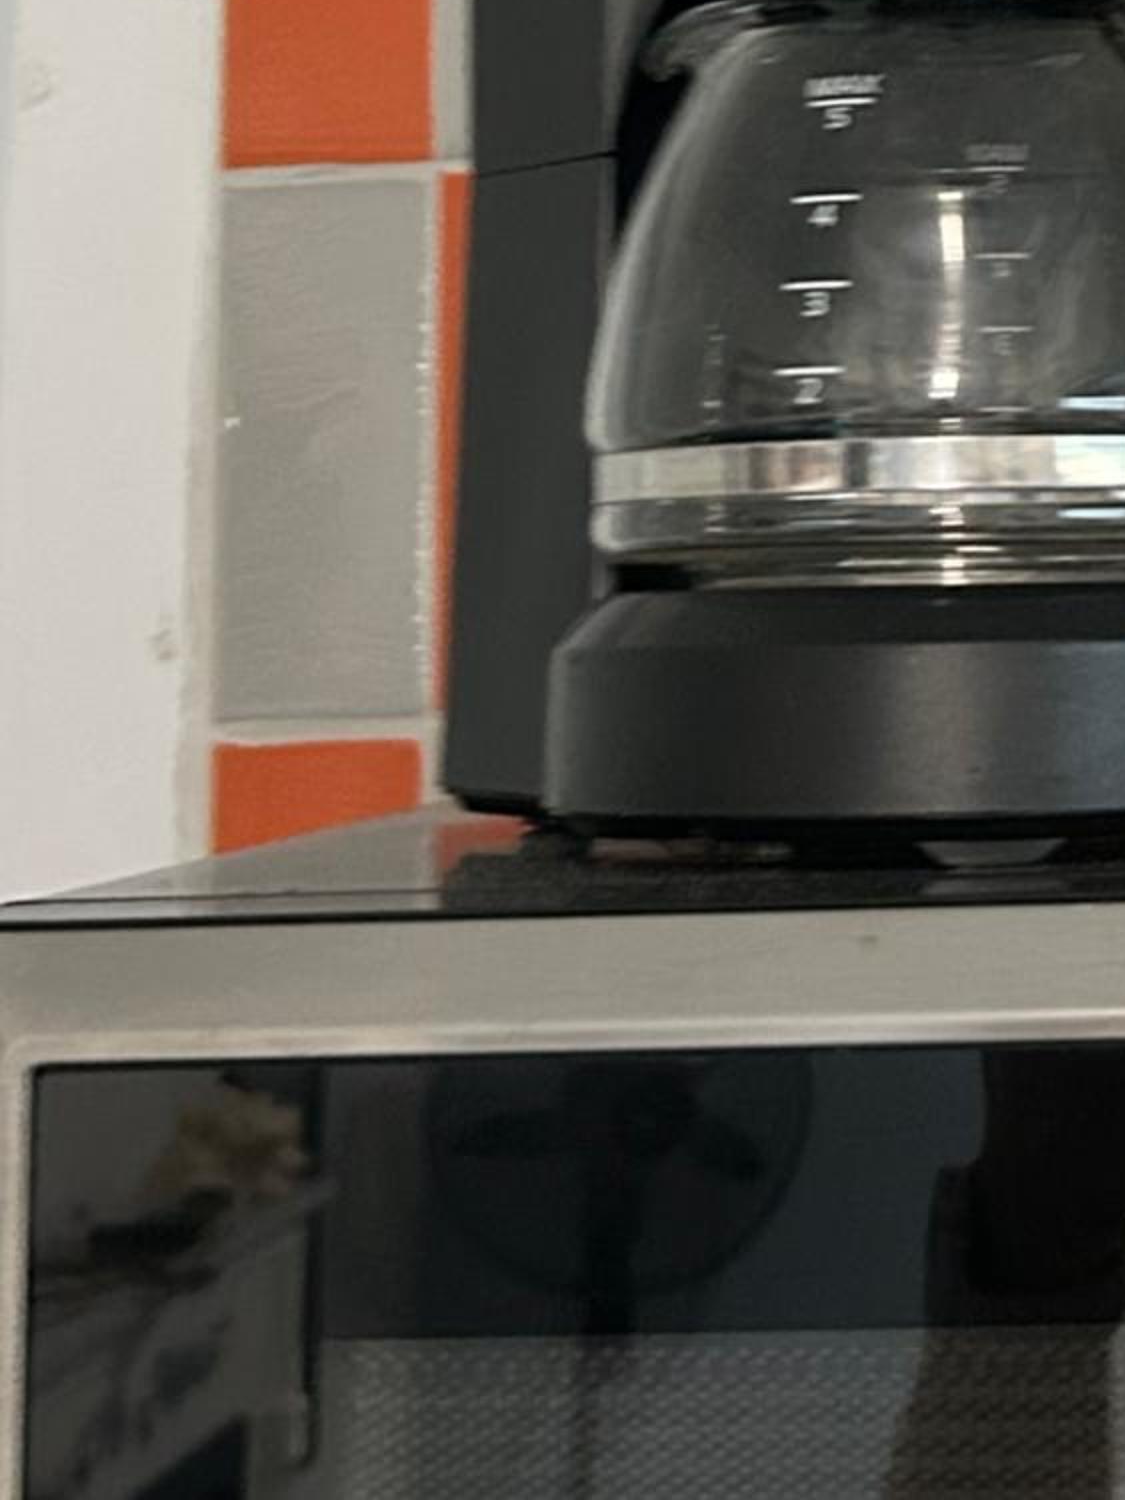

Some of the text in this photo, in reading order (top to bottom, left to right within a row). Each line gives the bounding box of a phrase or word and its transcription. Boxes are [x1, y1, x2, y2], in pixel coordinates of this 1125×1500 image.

[822, 107, 853, 130] 5
[800, 291, 830, 317] 3
[792, 377, 824, 404] 2
